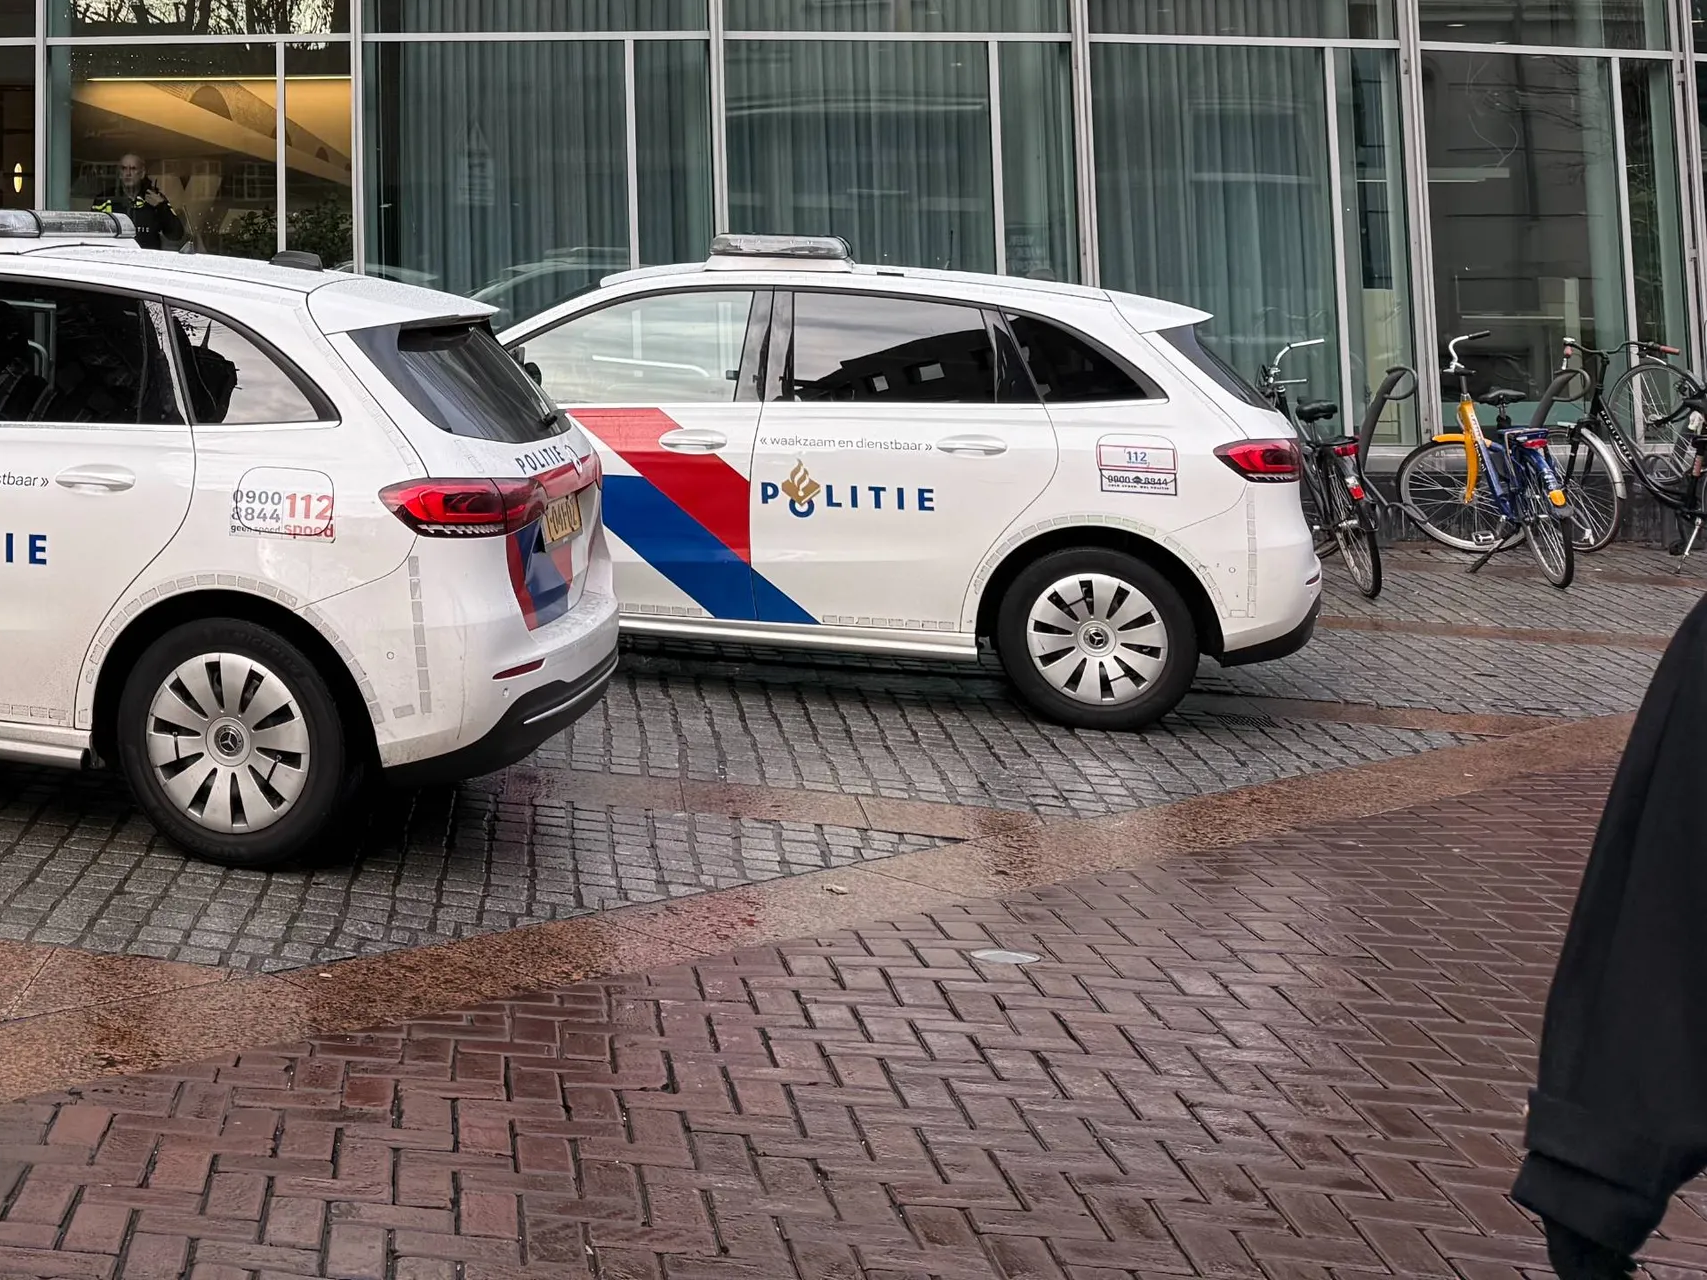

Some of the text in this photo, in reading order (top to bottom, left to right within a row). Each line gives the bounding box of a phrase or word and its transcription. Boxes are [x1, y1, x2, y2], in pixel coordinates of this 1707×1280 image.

[770, 435, 836, 448] waakzaam
[838, 438, 854, 449] en
[856, 437, 922, 451] dienstbaar
[514, 445, 565, 475] POLITIE
[1126, 450, 1147, 462] 112
[232, 489, 282, 506] 0900
[761, 482, 935, 518] POLITIE
[231, 506, 281, 523] 8844
[285, 492, 334, 521] 112
[283, 523, 334, 540] spoed
